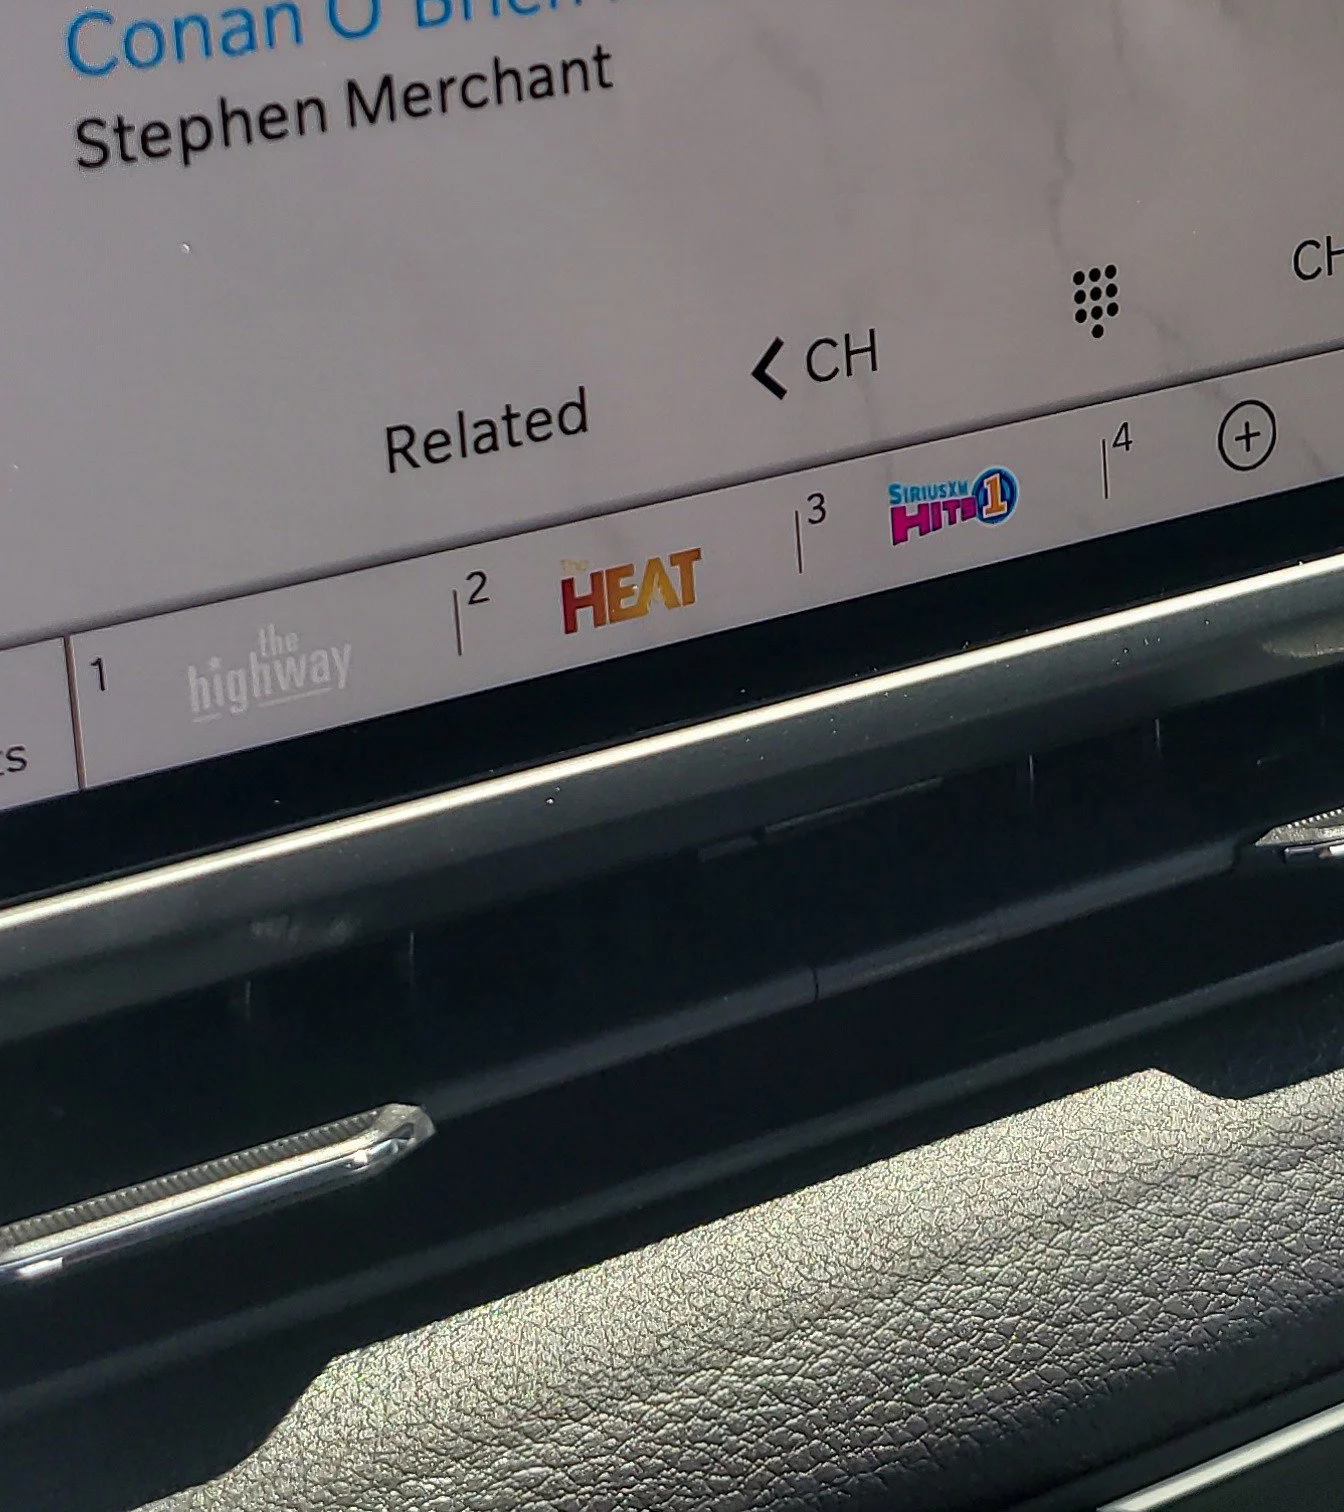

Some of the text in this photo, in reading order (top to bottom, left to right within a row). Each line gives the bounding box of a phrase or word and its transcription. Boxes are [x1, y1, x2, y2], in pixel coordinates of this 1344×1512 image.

[66, 0, 305, 77] Conan
[76, 43, 615, 170] Stephen Merchant
[805, 328, 879, 383] CH
[384, 386, 590, 474] Related
[1112, 421, 1133, 454] 4
[807, 492, 827, 525] 3
[467, 571, 490, 605] 2
[560, 547, 702, 635] HEAT
[259, 623, 300, 657] the
[89, 657, 108, 692] 1
[186, 642, 353, 718] highway
